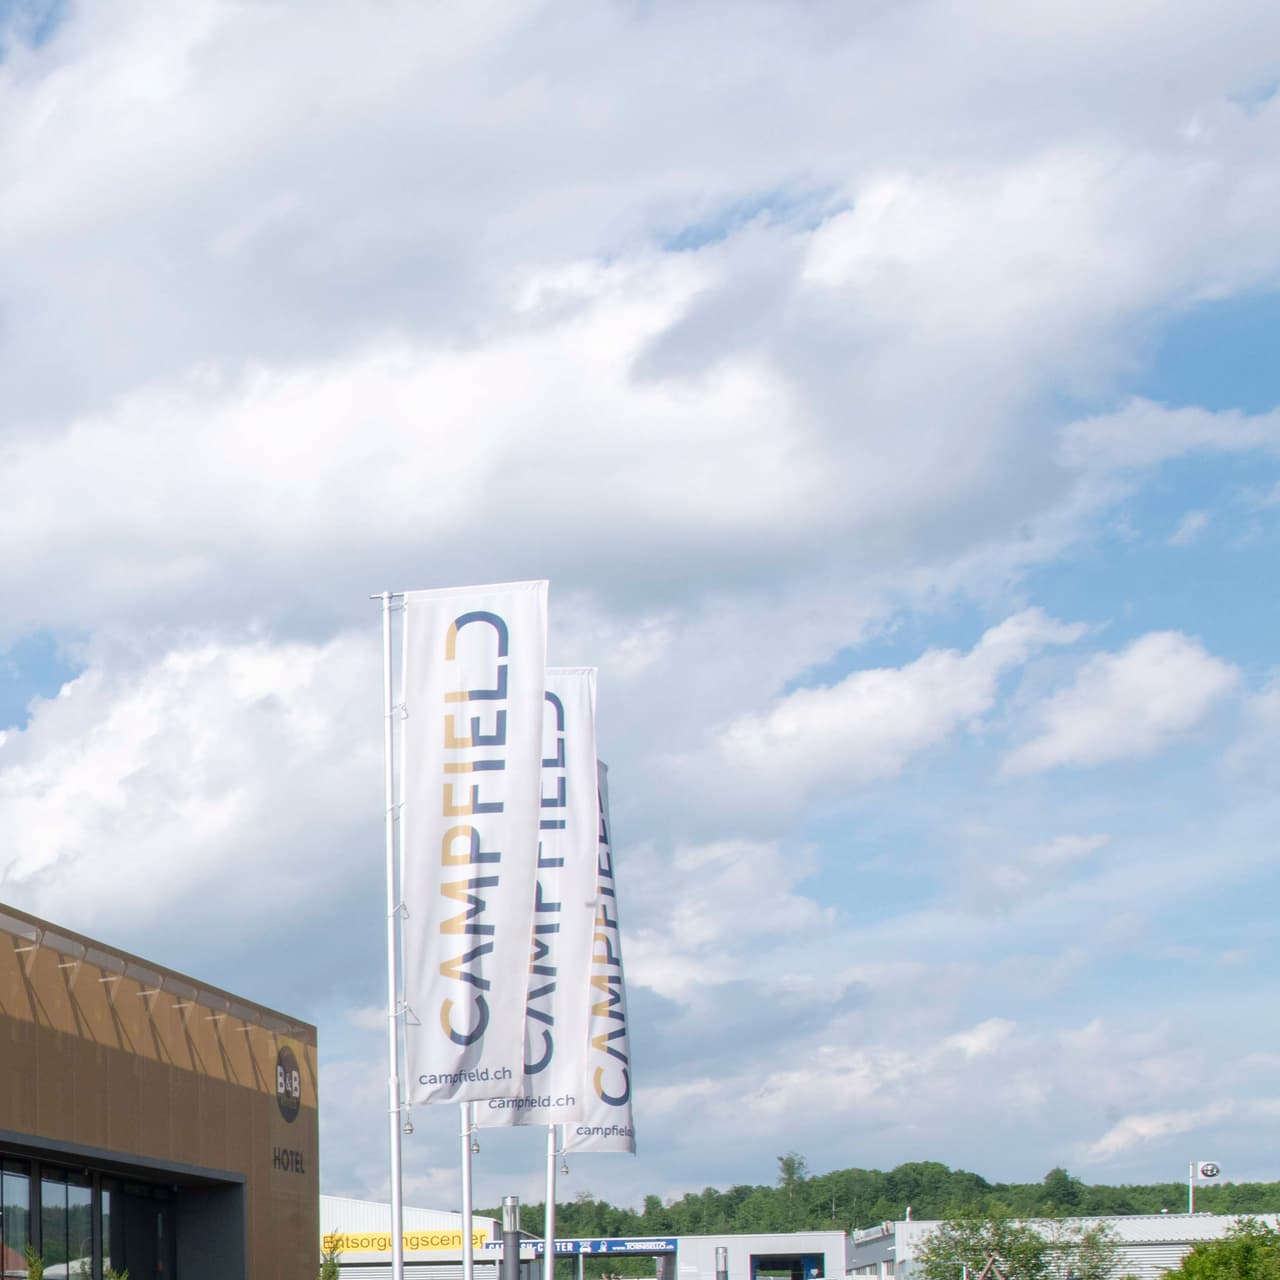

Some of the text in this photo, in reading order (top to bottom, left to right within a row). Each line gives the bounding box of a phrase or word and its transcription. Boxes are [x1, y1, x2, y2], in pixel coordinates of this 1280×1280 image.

[439, 609, 509, 1047] CAMPFIELD
[276, 1065, 301, 1099] B&B
[418, 1066, 513, 1086] campfield.ch
[488, 1094, 576, 1112] campfield.ch
[272, 1146, 306, 1175] HOTEL
